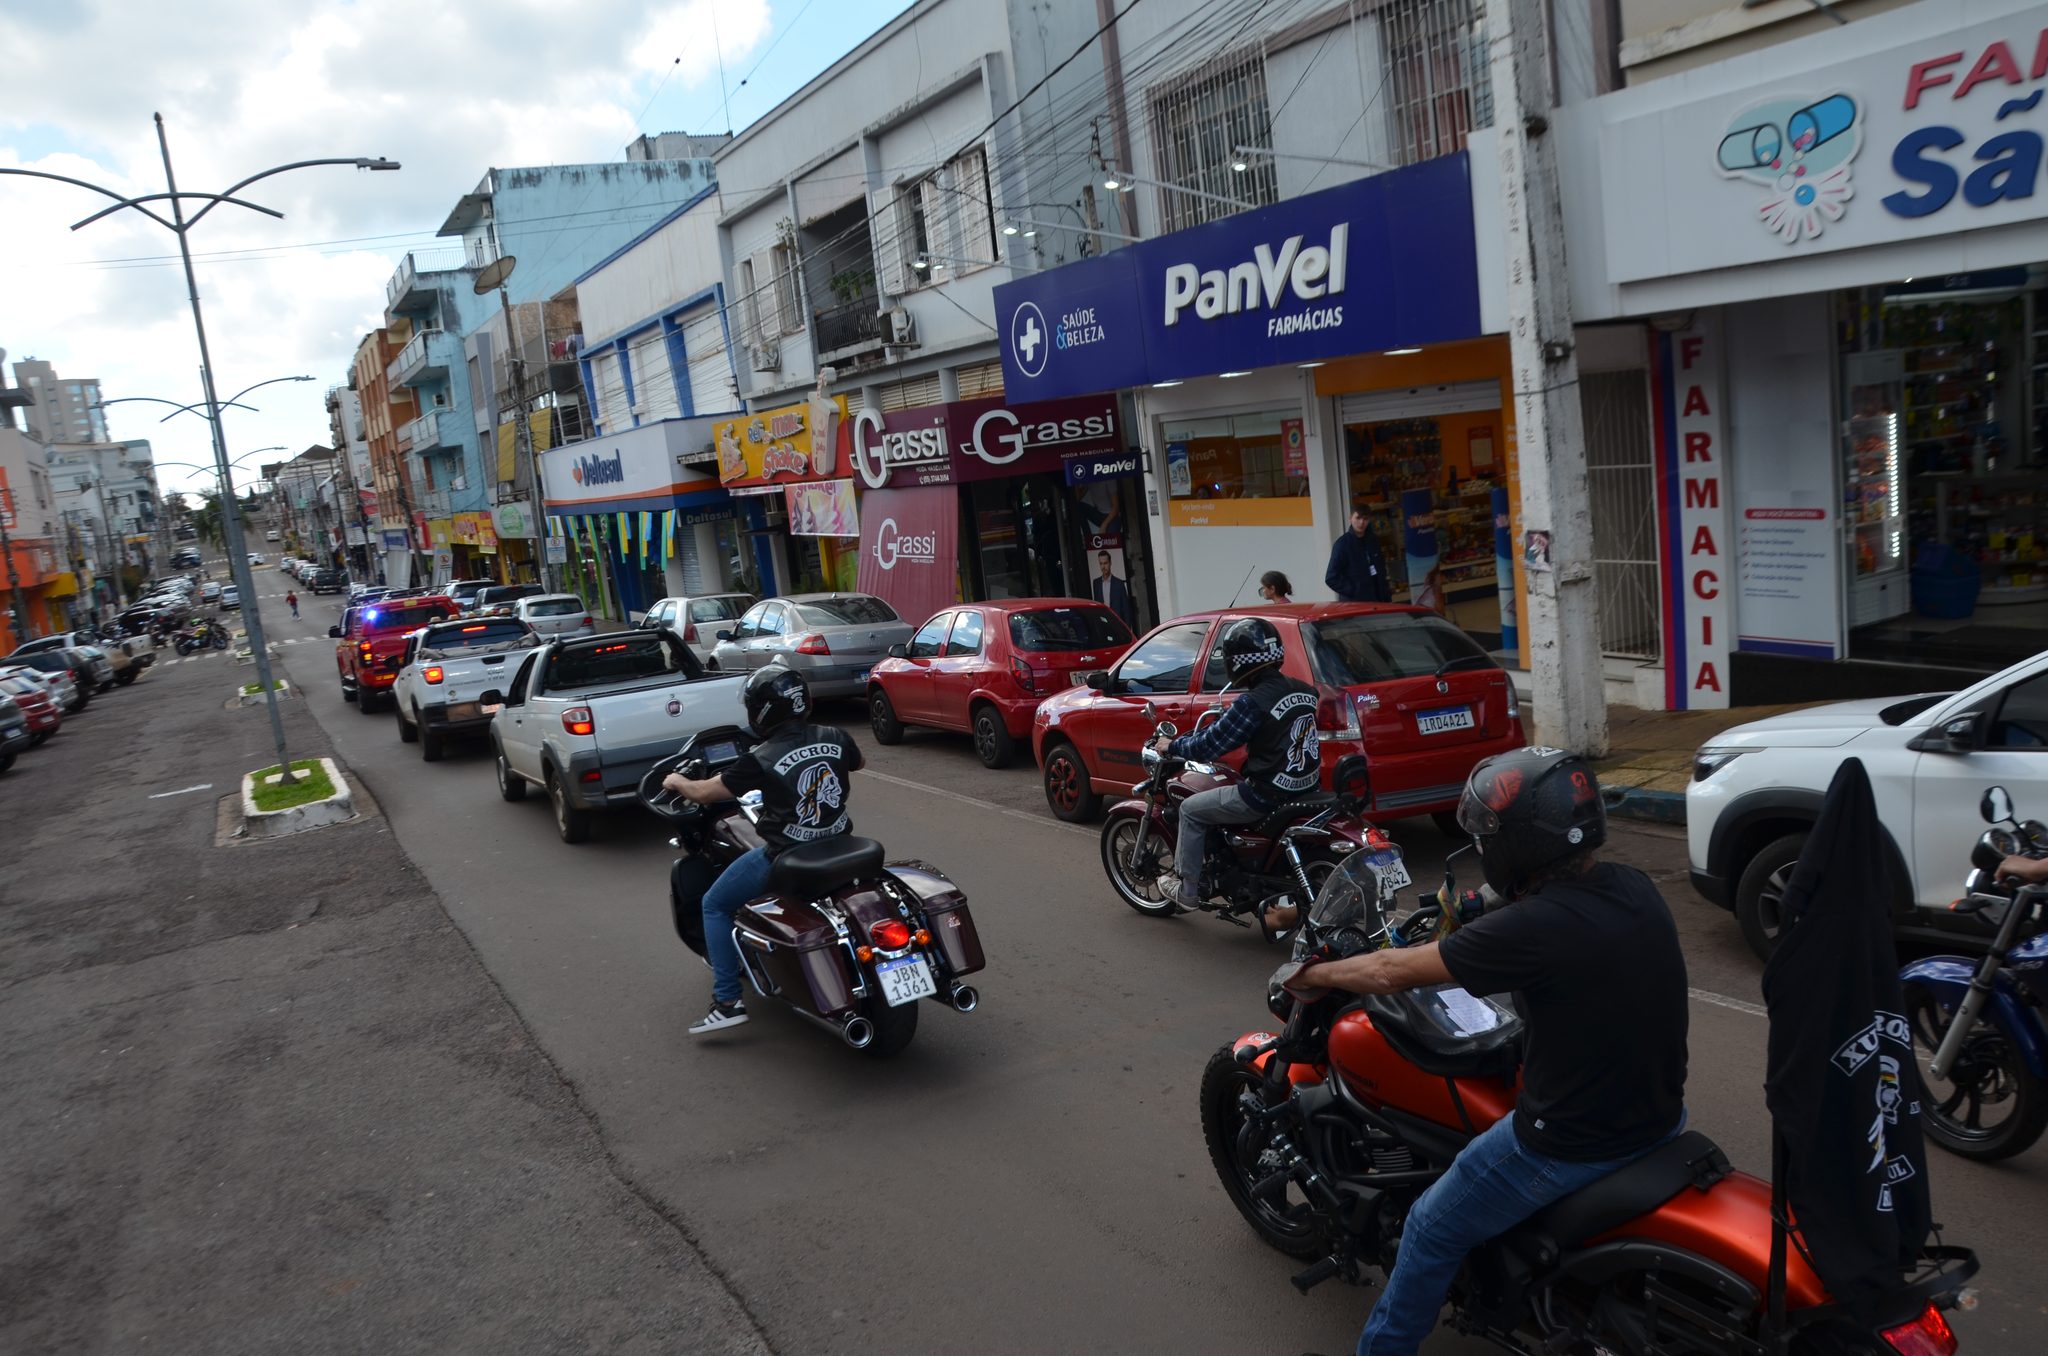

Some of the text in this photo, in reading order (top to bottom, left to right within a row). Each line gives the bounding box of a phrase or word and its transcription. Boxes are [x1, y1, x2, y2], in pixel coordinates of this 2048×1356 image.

[1164, 222, 1349, 327] PanVel
[1062, 308, 1097, 330] SAÚDE
[1267, 306, 1343, 338] FARMÁCIAS
[849, 407, 948, 489] Grassi
[960, 409, 1115, 465] Grassi
[581, 448, 624, 487] Deltasul
[1093, 459, 1136, 475] PanVel
[686, 509, 732, 524] Deltasul
[1680, 337, 1721, 693] FARMACIA
[872, 518, 935, 570] Grassi
[1275, 694, 1318, 717] XUCROS
[1424, 713, 1468, 732] IRD4A21
[779, 744, 839, 773] XUCROS
[1277, 775, 1290, 788] RIO
[786, 826, 801, 838] RIO
[803, 829, 833, 840] GRANDE
[893, 963, 920, 984] JBN
[892, 977, 930, 1001] 1J61
